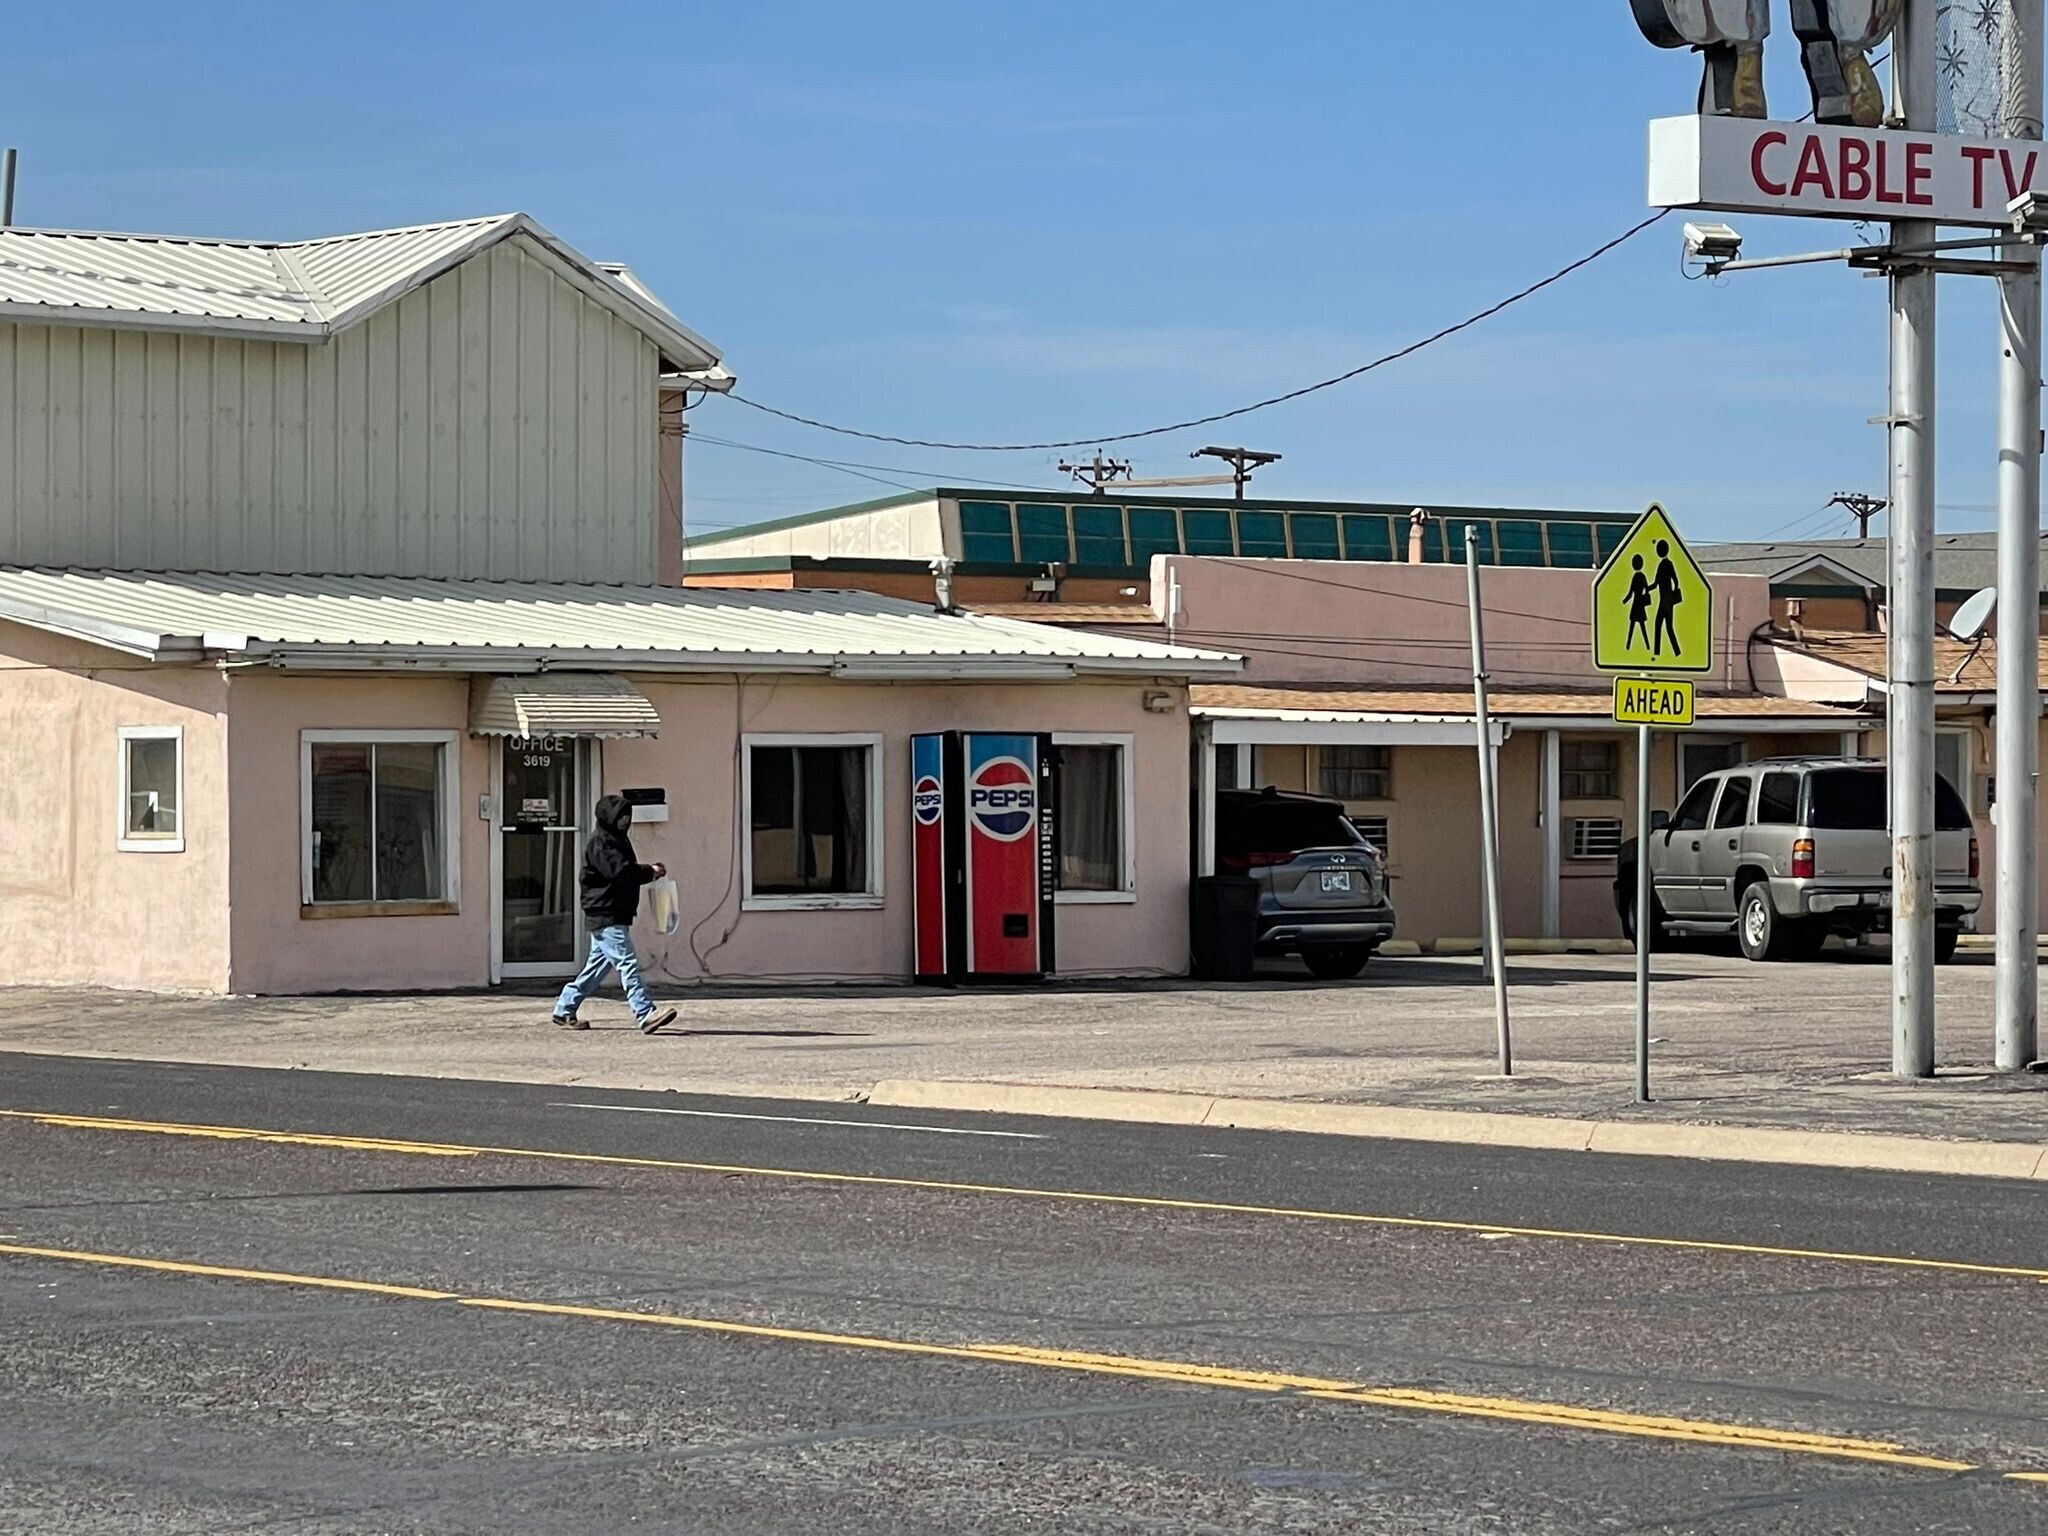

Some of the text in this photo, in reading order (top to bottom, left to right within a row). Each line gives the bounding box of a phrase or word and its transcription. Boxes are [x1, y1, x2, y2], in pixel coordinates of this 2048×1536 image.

[1751, 131, 2038, 209] CABLE TV
[1624, 687, 1684, 715] AHEAD
[510, 736, 564, 752] OFFICE
[523, 754, 551, 767] 3619
[971, 789, 1035, 808] PEPSI
